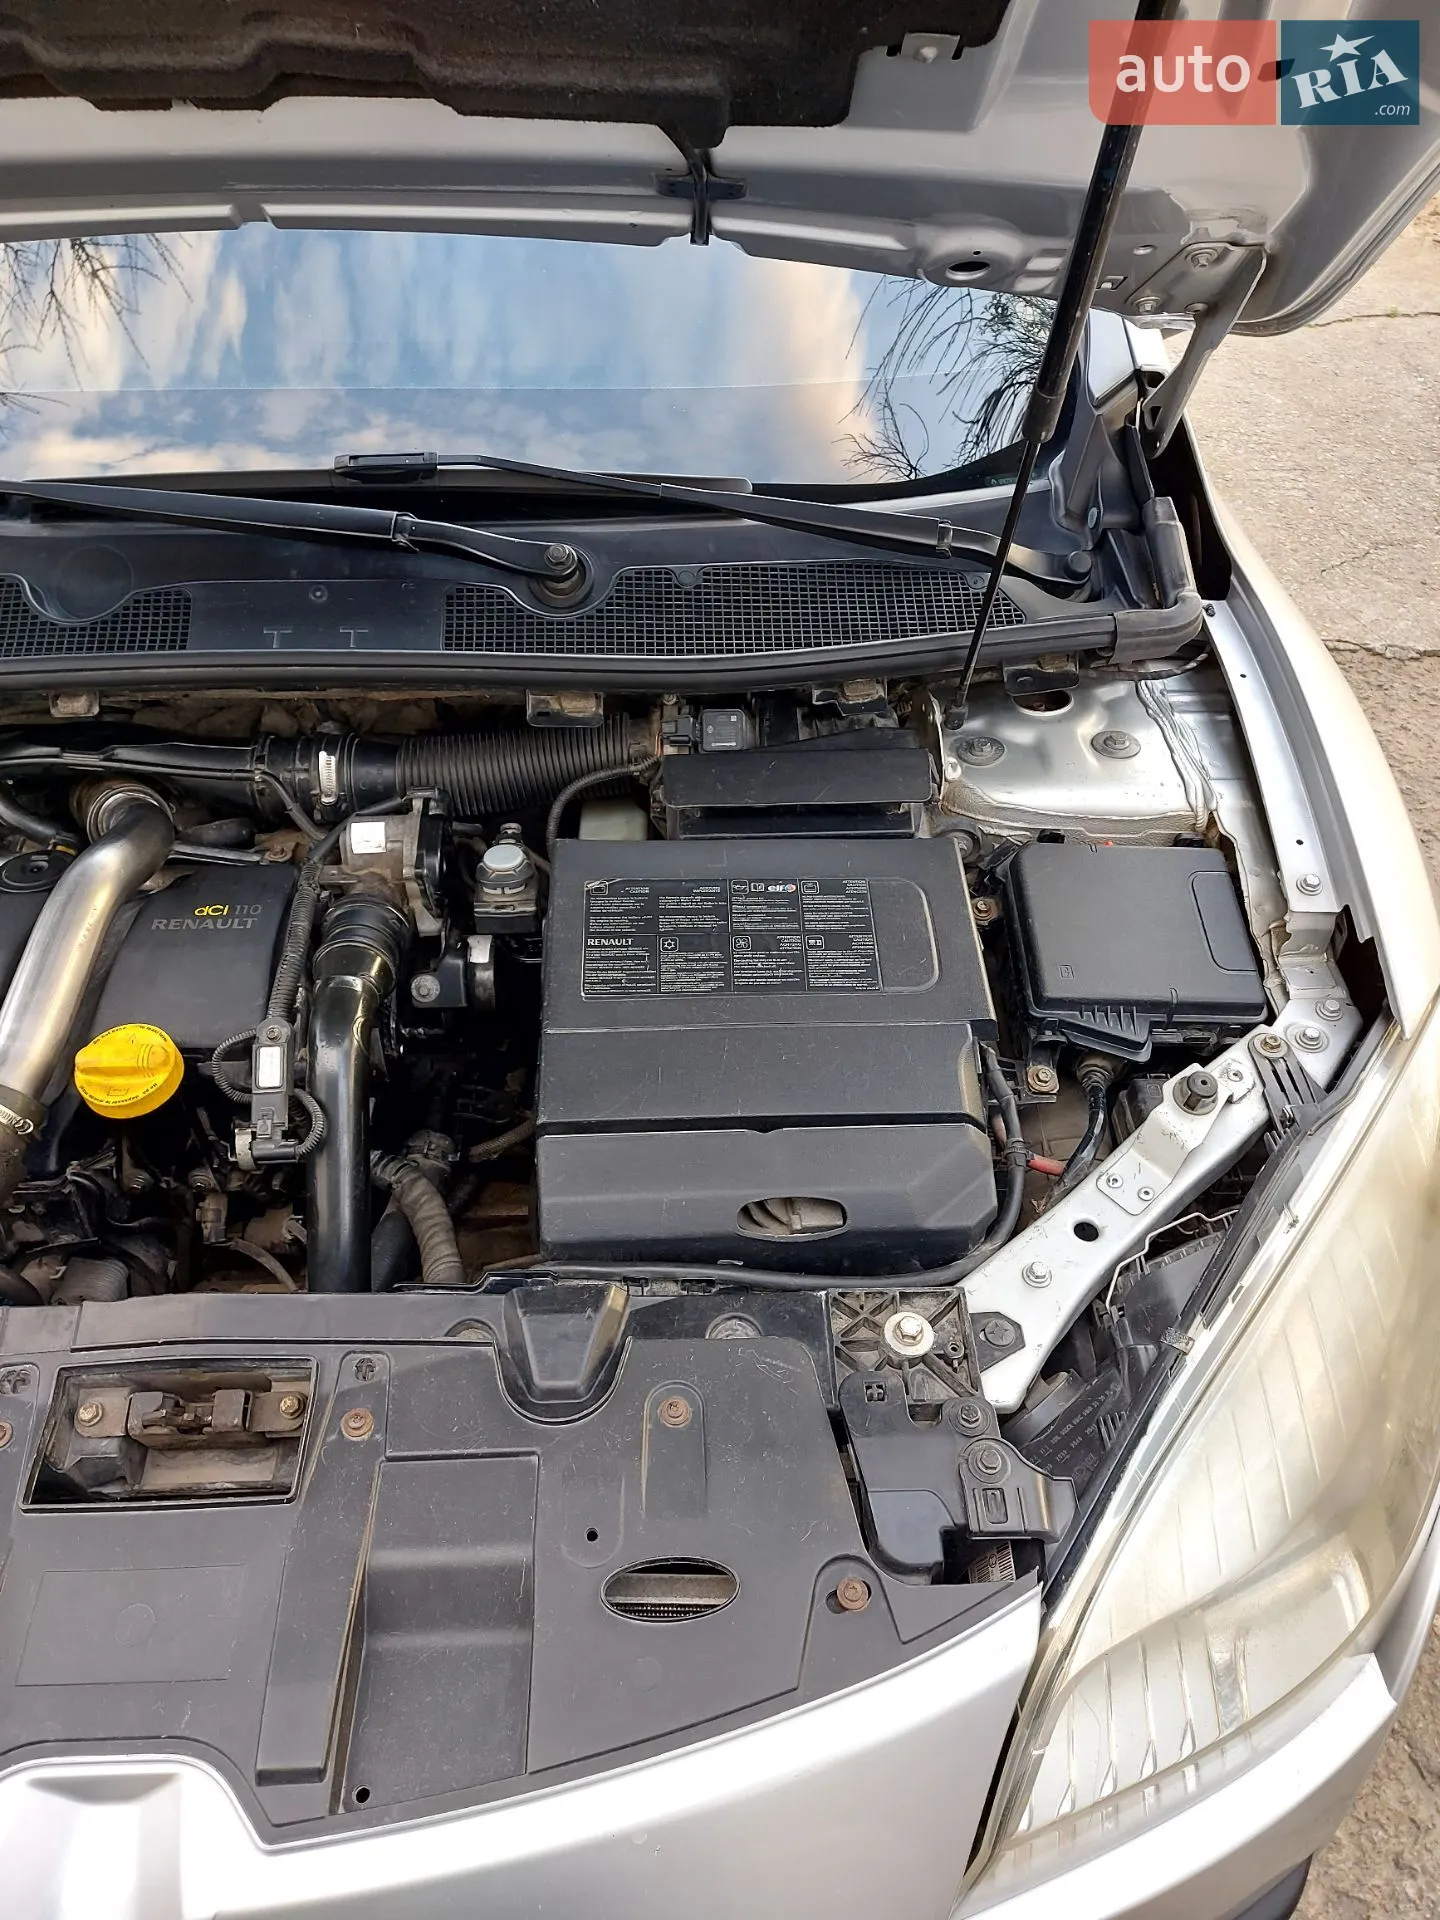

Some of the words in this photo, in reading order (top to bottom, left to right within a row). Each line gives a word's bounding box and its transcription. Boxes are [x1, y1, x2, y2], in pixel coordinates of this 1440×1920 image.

[767, 884, 786, 892] elf
[235, 904, 262, 916] 110
[151, 918, 258, 931] RENAULT
[586, 938, 634, 946] RENAULT
